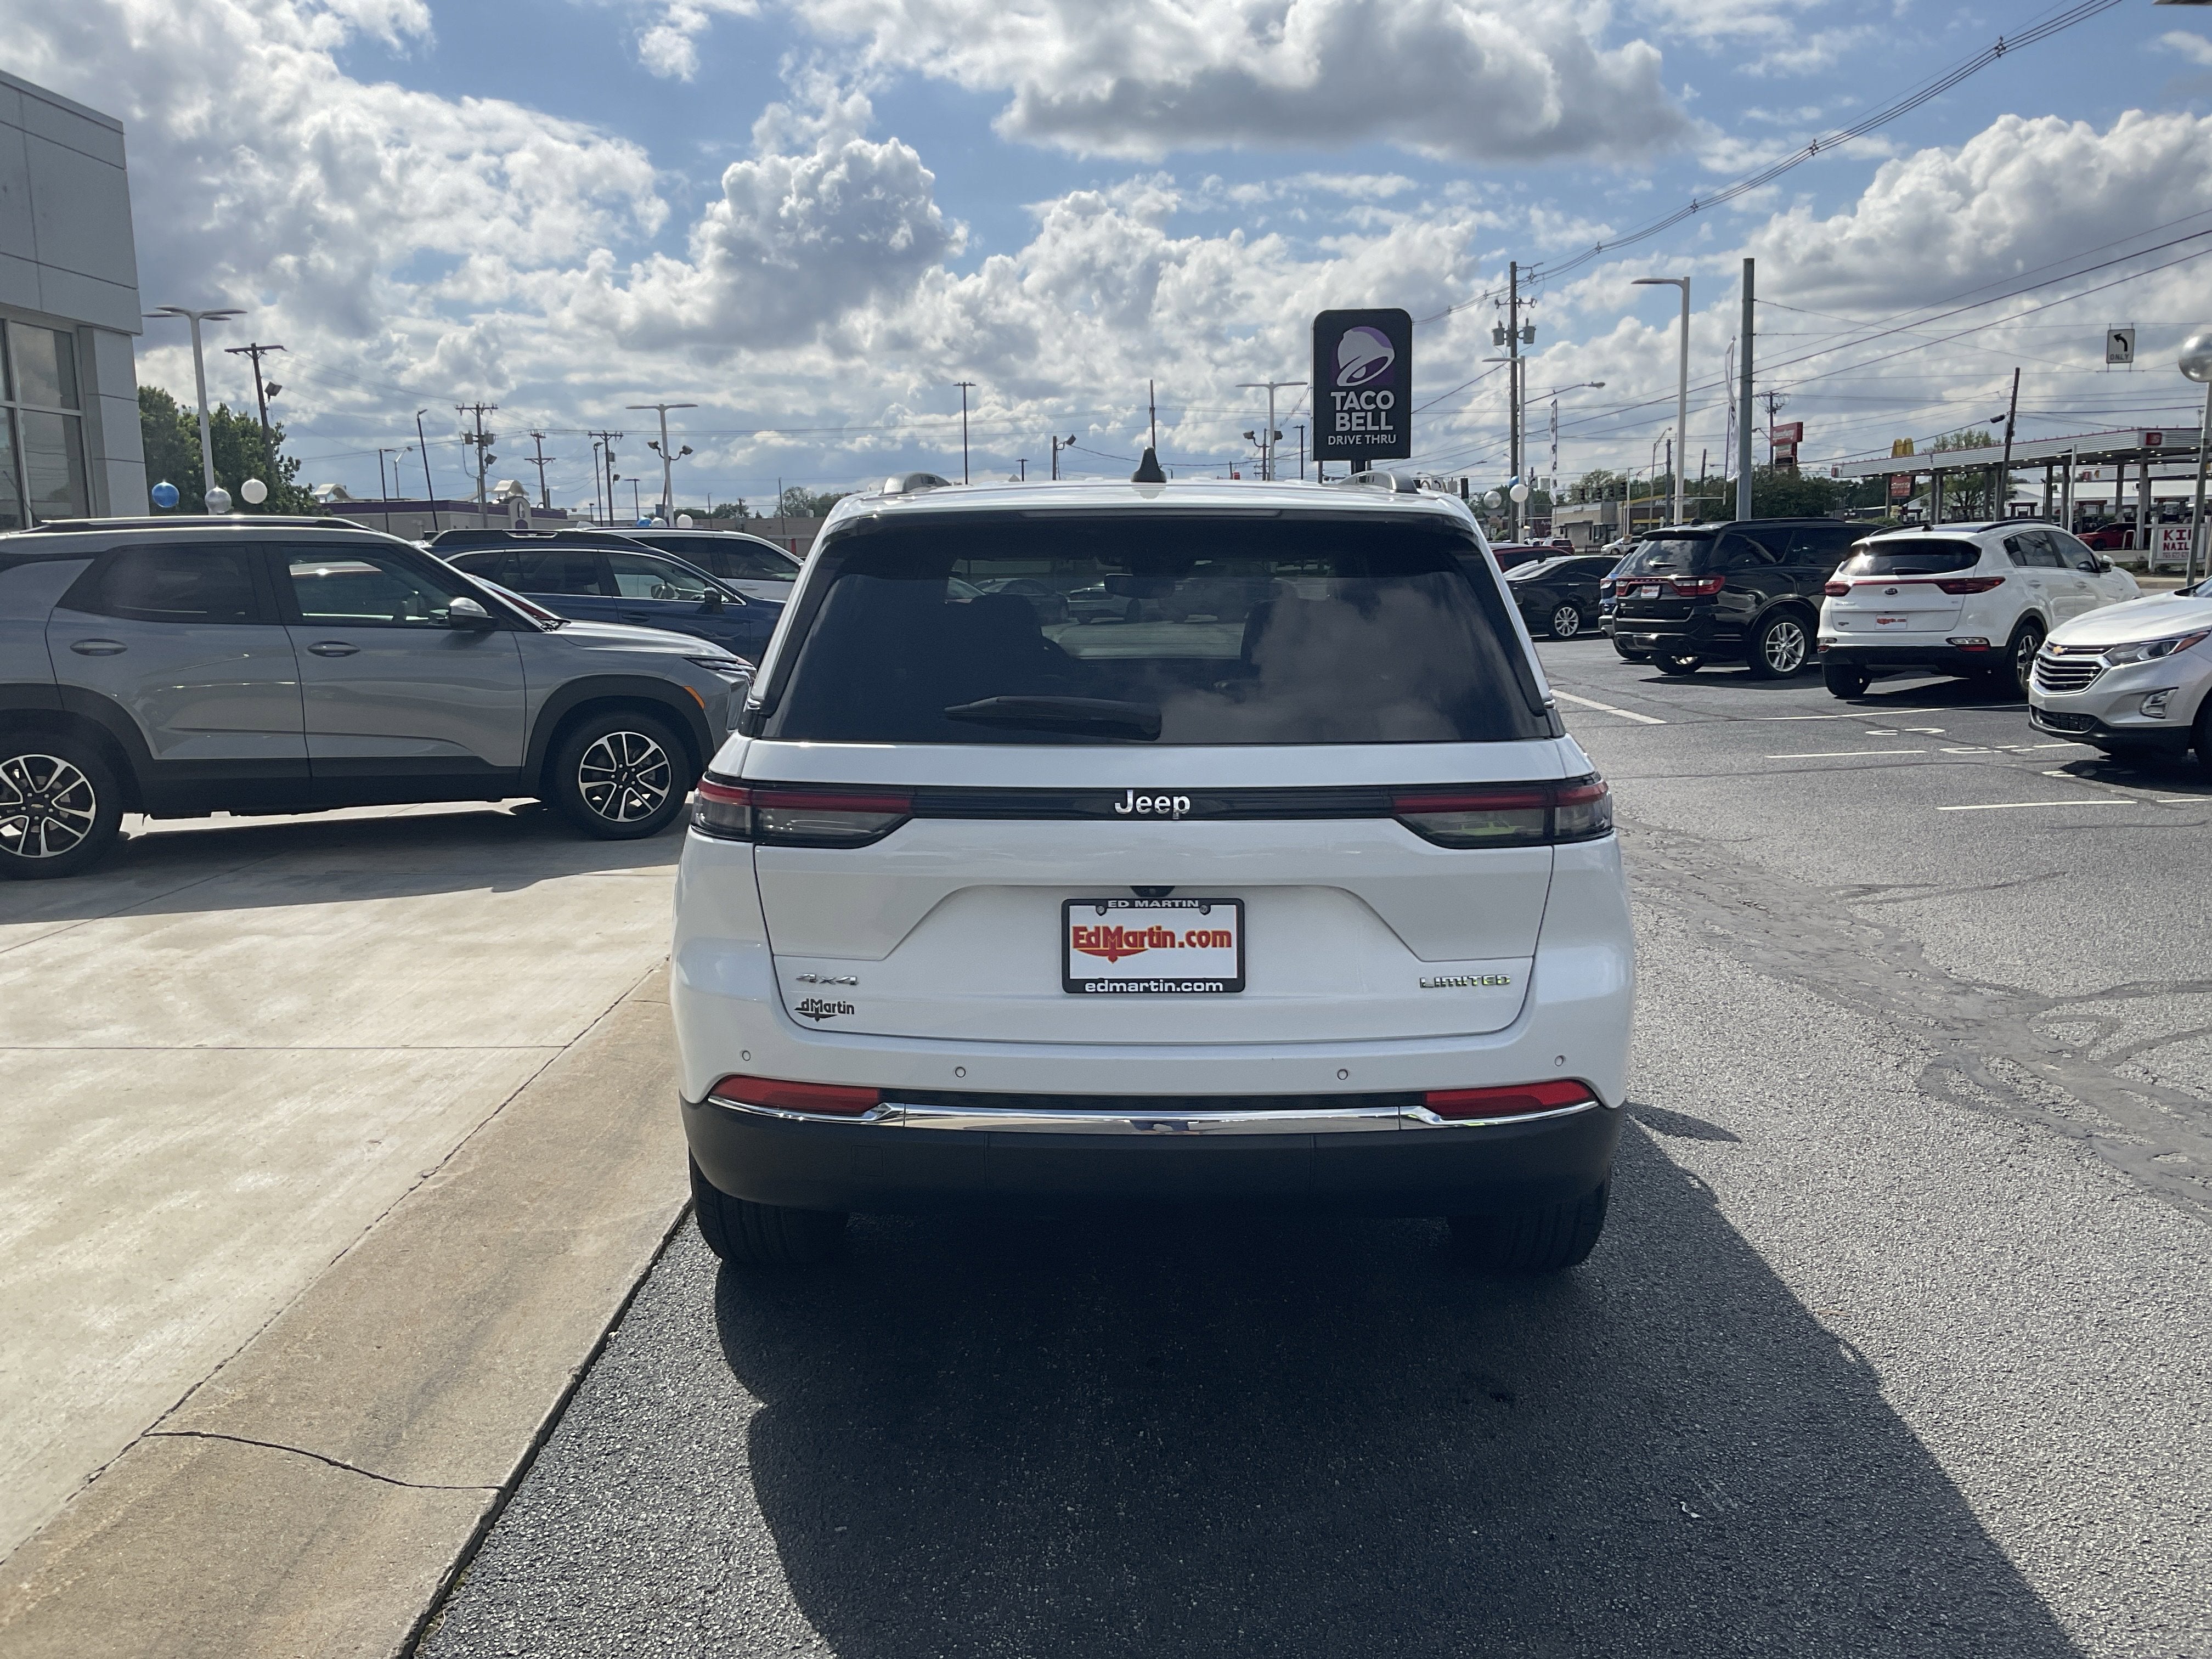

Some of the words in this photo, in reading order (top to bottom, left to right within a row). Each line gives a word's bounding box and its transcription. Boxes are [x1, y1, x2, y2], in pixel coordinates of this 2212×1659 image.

[1330, 391, 1395, 410] TACO
[1335, 411, 1393, 431] BELL
[1328, 435, 1362, 445] DRIVE
[1364, 434, 1397, 444] THRU
[2164, 529, 2191, 541] KI
[2163, 541, 2190, 551] NAIL
[1115, 789, 1190, 820] Jeep
[1135, 900, 1199, 908] MARTIN
[1072, 925, 1232, 949] EdMartin.com
[795, 973, 859, 985] 4x4
[1085, 979, 1223, 992] edmartin.com
[1419, 974, 1510, 988] LIMITED
[794, 998, 855, 1015] dMartin
